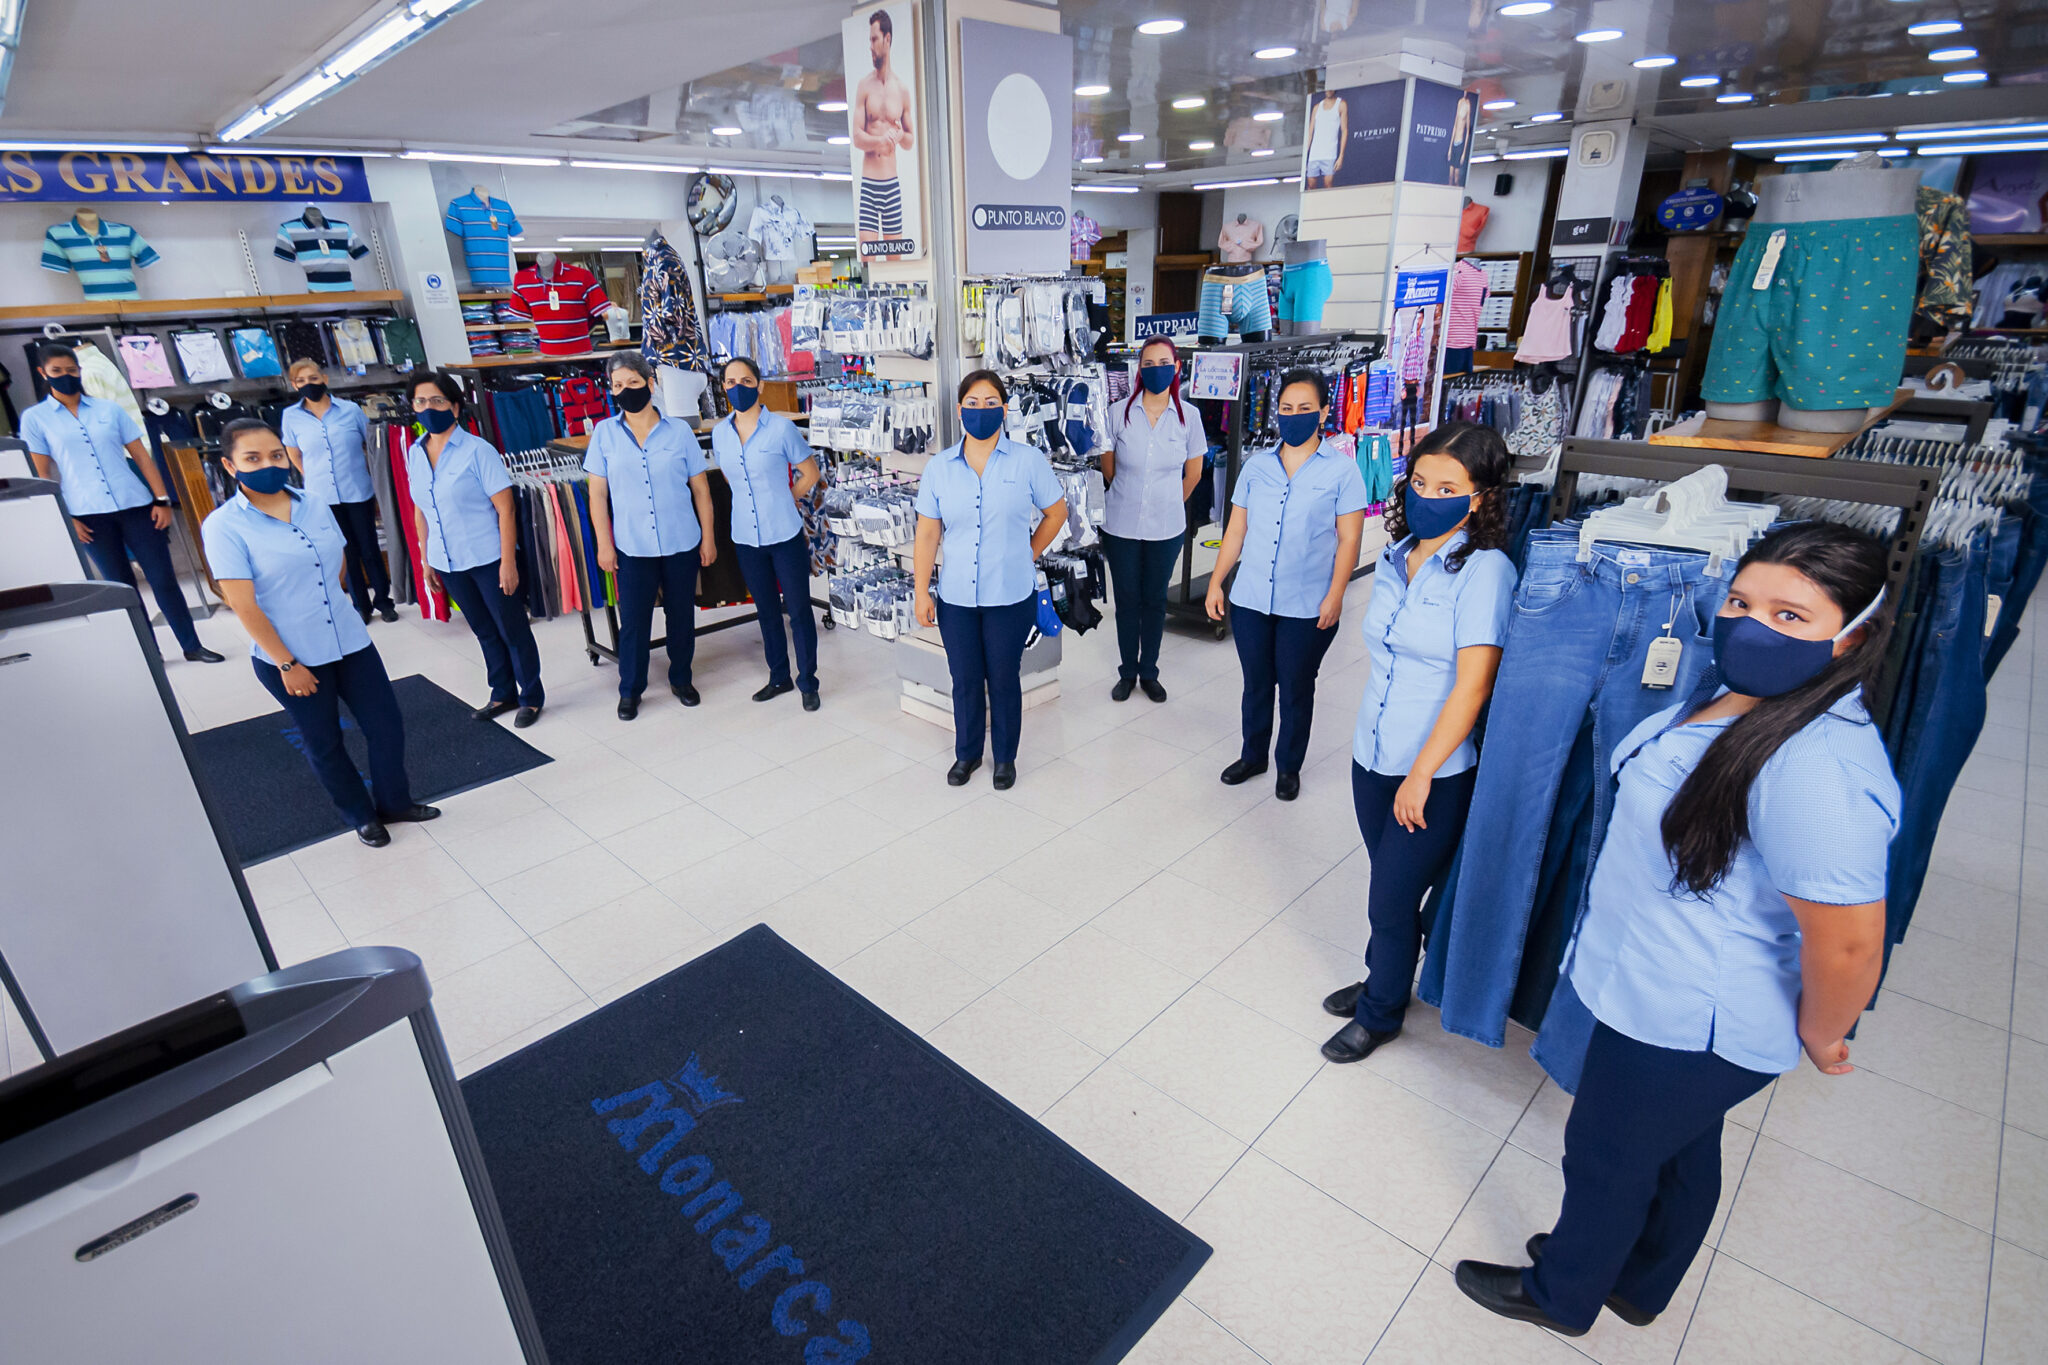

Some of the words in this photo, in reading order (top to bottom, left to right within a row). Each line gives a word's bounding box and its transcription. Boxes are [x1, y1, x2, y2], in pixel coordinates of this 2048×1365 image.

[1353, 126, 1395, 139] PATPRIMO
[1416, 123, 1447, 138] PATPRIMO
[0, 150, 43, 193] S
[57, 151, 344, 196] GRANDES
[987, 209, 1023, 225] PUNTO
[1024, 210, 1064, 226] BLANCO
[1572, 223, 1590, 236] gef
[868, 242, 887, 254] PUNTO
[888, 240, 914, 253] BLANCO
[1136, 317, 1199, 337] PATPRIM
[591, 1079, 872, 1365] Monarca
